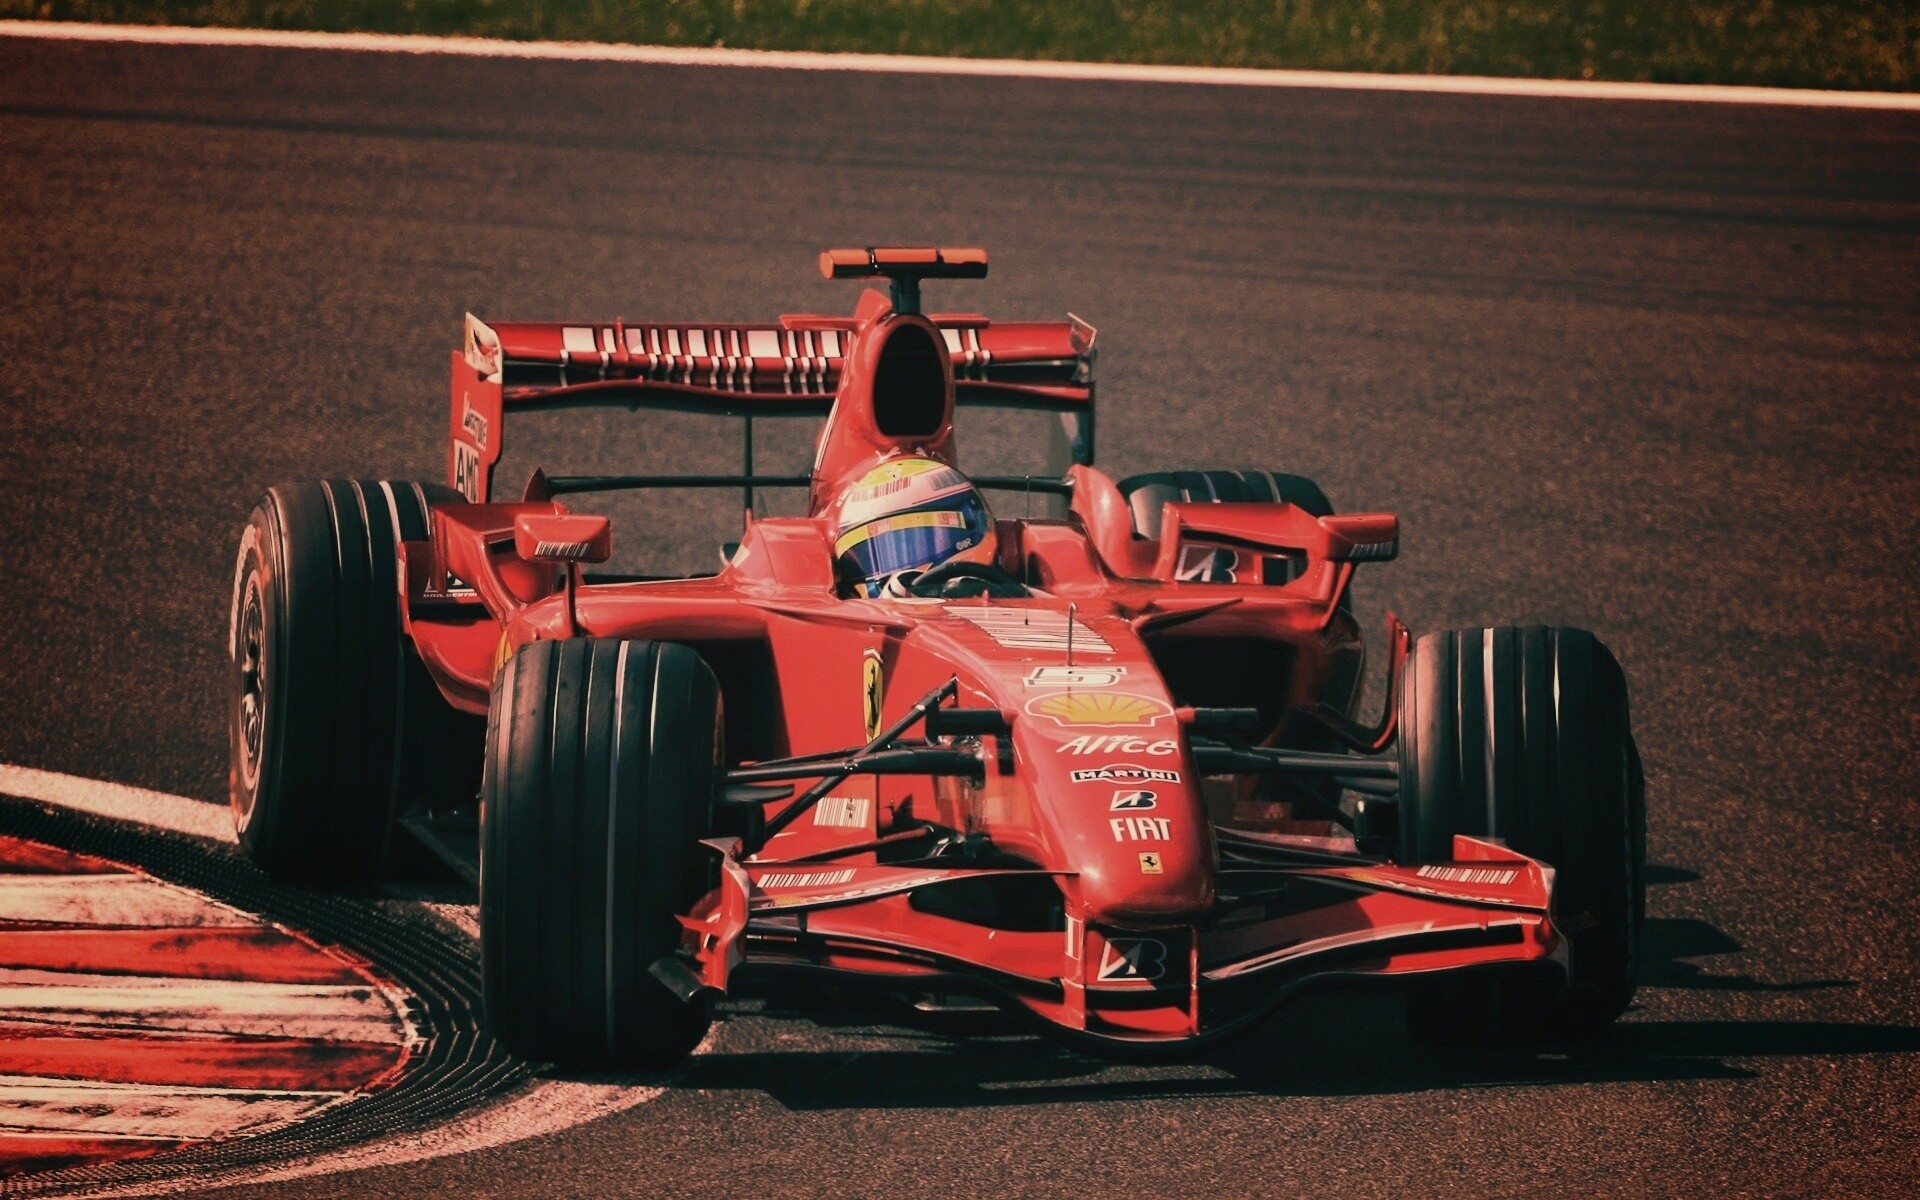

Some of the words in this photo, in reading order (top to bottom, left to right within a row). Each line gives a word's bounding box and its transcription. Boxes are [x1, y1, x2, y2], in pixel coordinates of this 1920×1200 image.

[1056, 734, 1178, 756] Alice
[1079, 770, 1174, 781] MARTINI
[1109, 817, 1171, 842] FIAT
